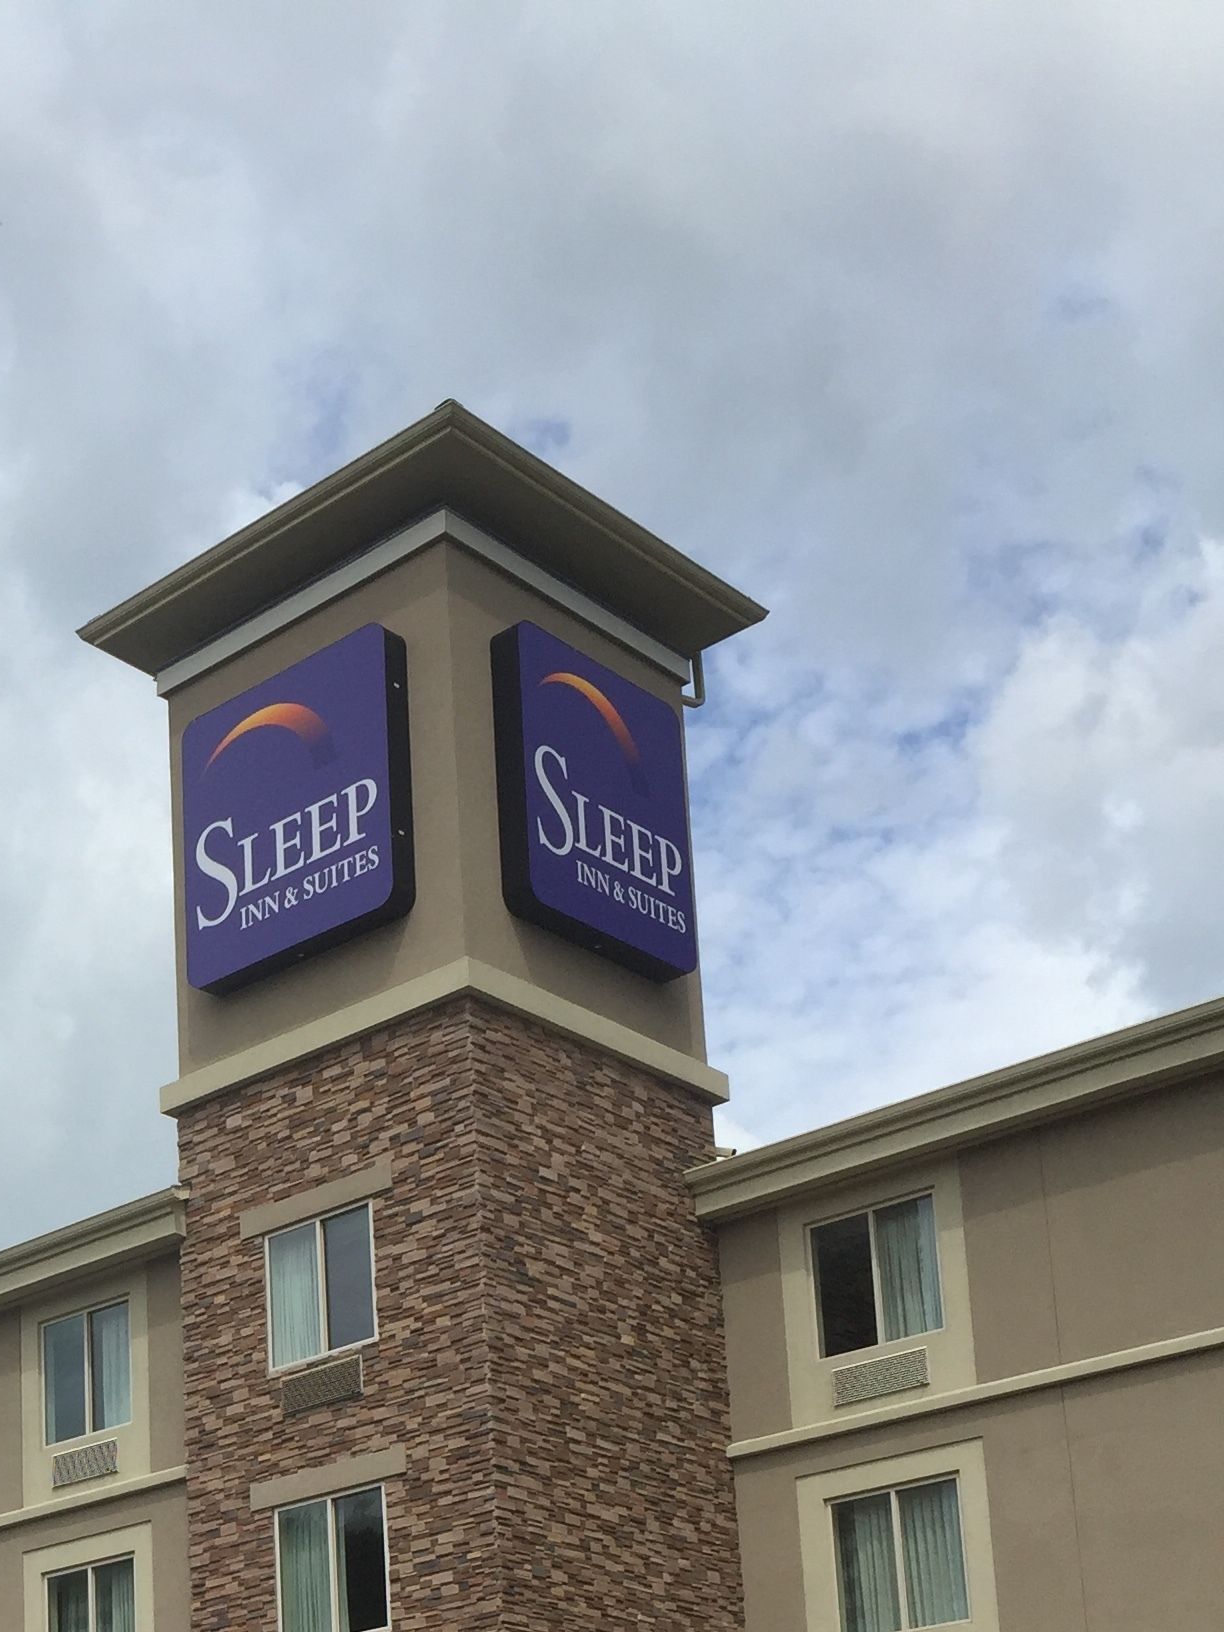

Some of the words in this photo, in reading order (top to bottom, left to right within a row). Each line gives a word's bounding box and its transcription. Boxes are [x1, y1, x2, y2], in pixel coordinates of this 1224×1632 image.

[195, 778, 378, 930] SLEEP
[534, 745, 682, 896] SLEEP
[239, 891, 280, 930] INN
[284, 886, 299, 909] &
[303, 845, 380, 900] SUITES
[576, 859, 611, 896] INN
[613, 880, 625, 903] &
[628, 886, 687, 934] SUITES
